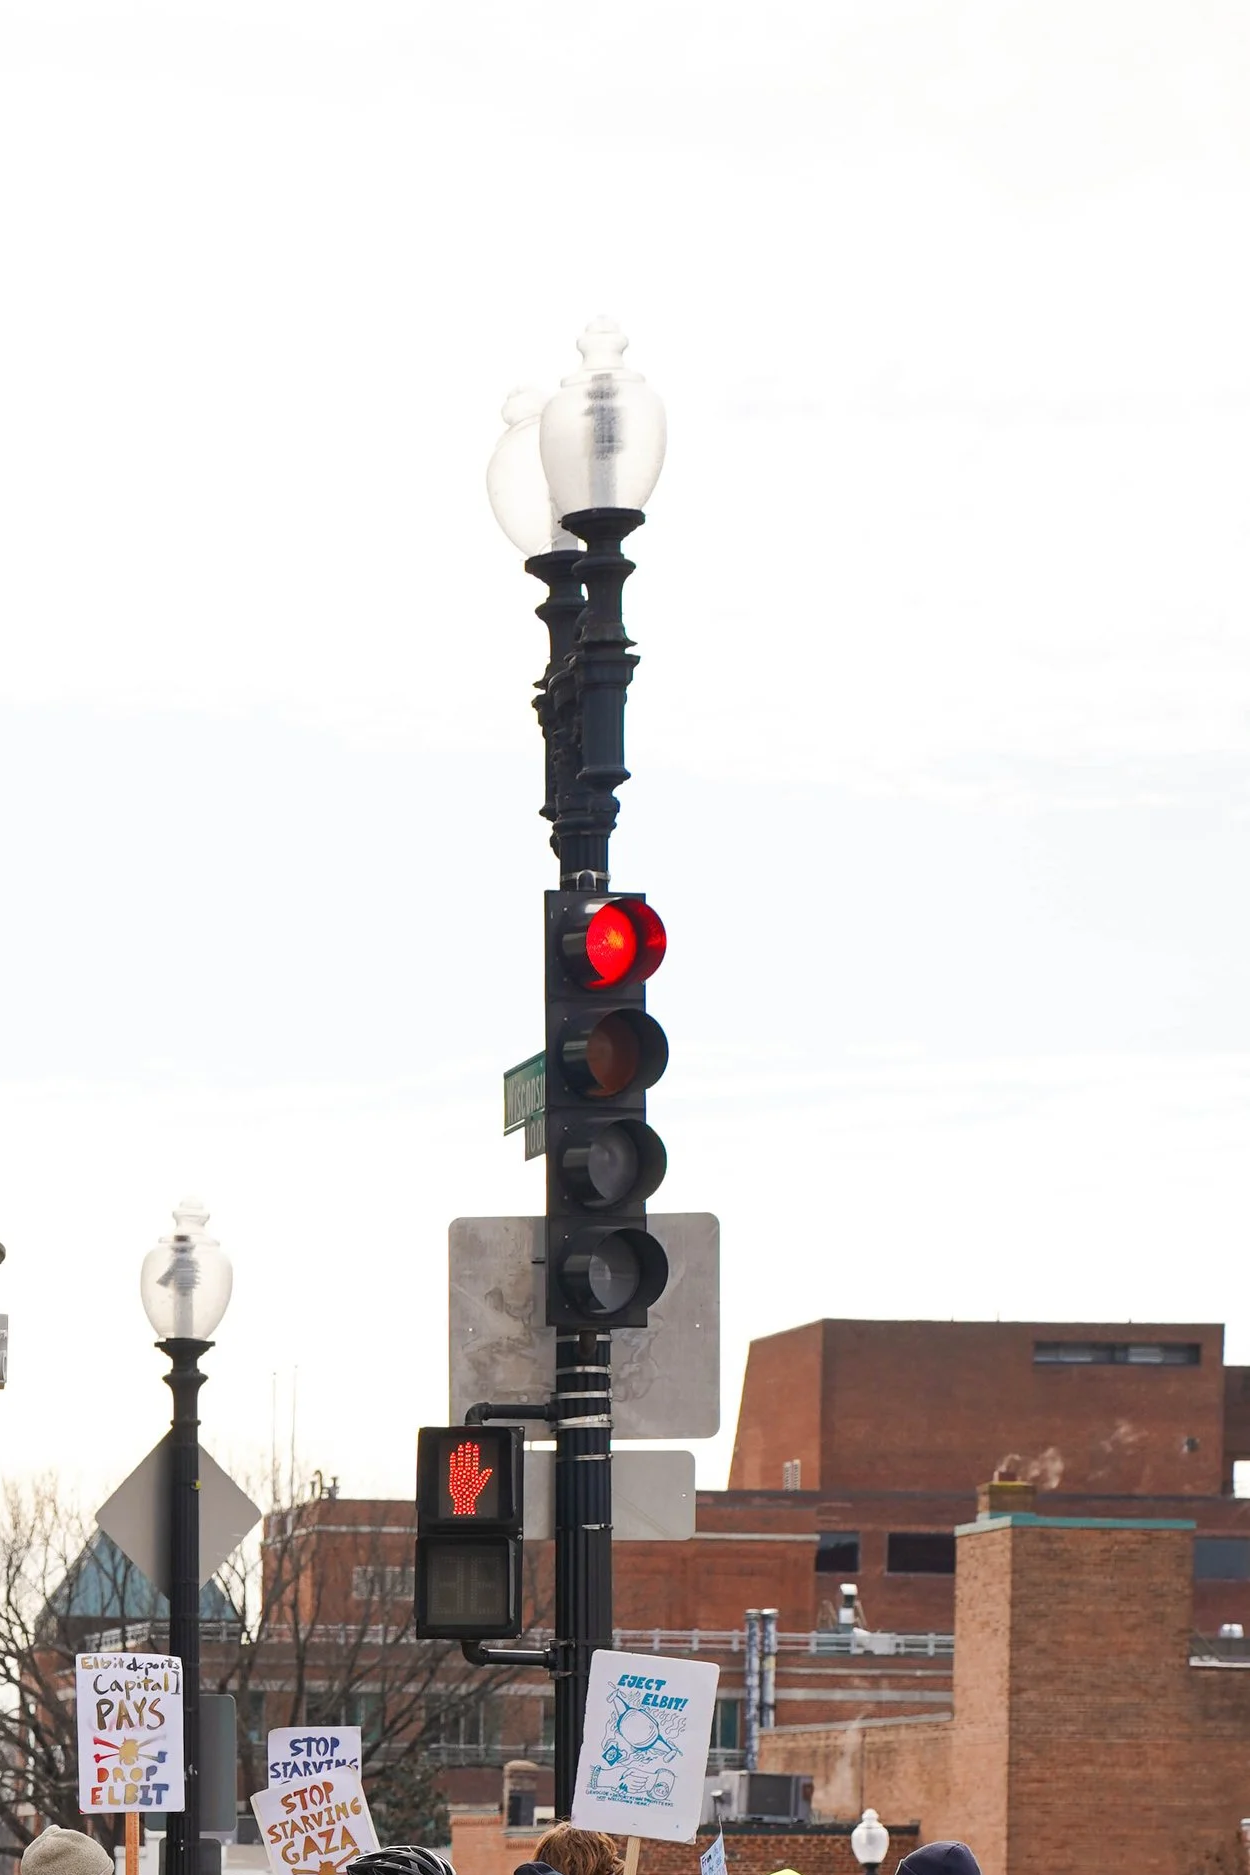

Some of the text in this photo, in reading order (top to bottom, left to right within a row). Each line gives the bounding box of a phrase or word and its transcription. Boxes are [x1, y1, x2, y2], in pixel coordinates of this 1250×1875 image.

[81, 1656, 125, 1670] Elbit
[93, 1672, 170, 1700] Capital
[617, 1674, 667, 1692] EJECT
[96, 1697, 166, 1730] PAYS
[641, 1693, 689, 1712] ELBIT!
[289, 1736, 340, 1757] STOP
[97, 1765, 158, 1783] DROP
[91, 1783, 170, 1806] ELBIT
[280, 1781, 334, 1815] STOP
[267, 1797, 363, 1844] STARVING
[281, 1825, 358, 1866] GAZA
